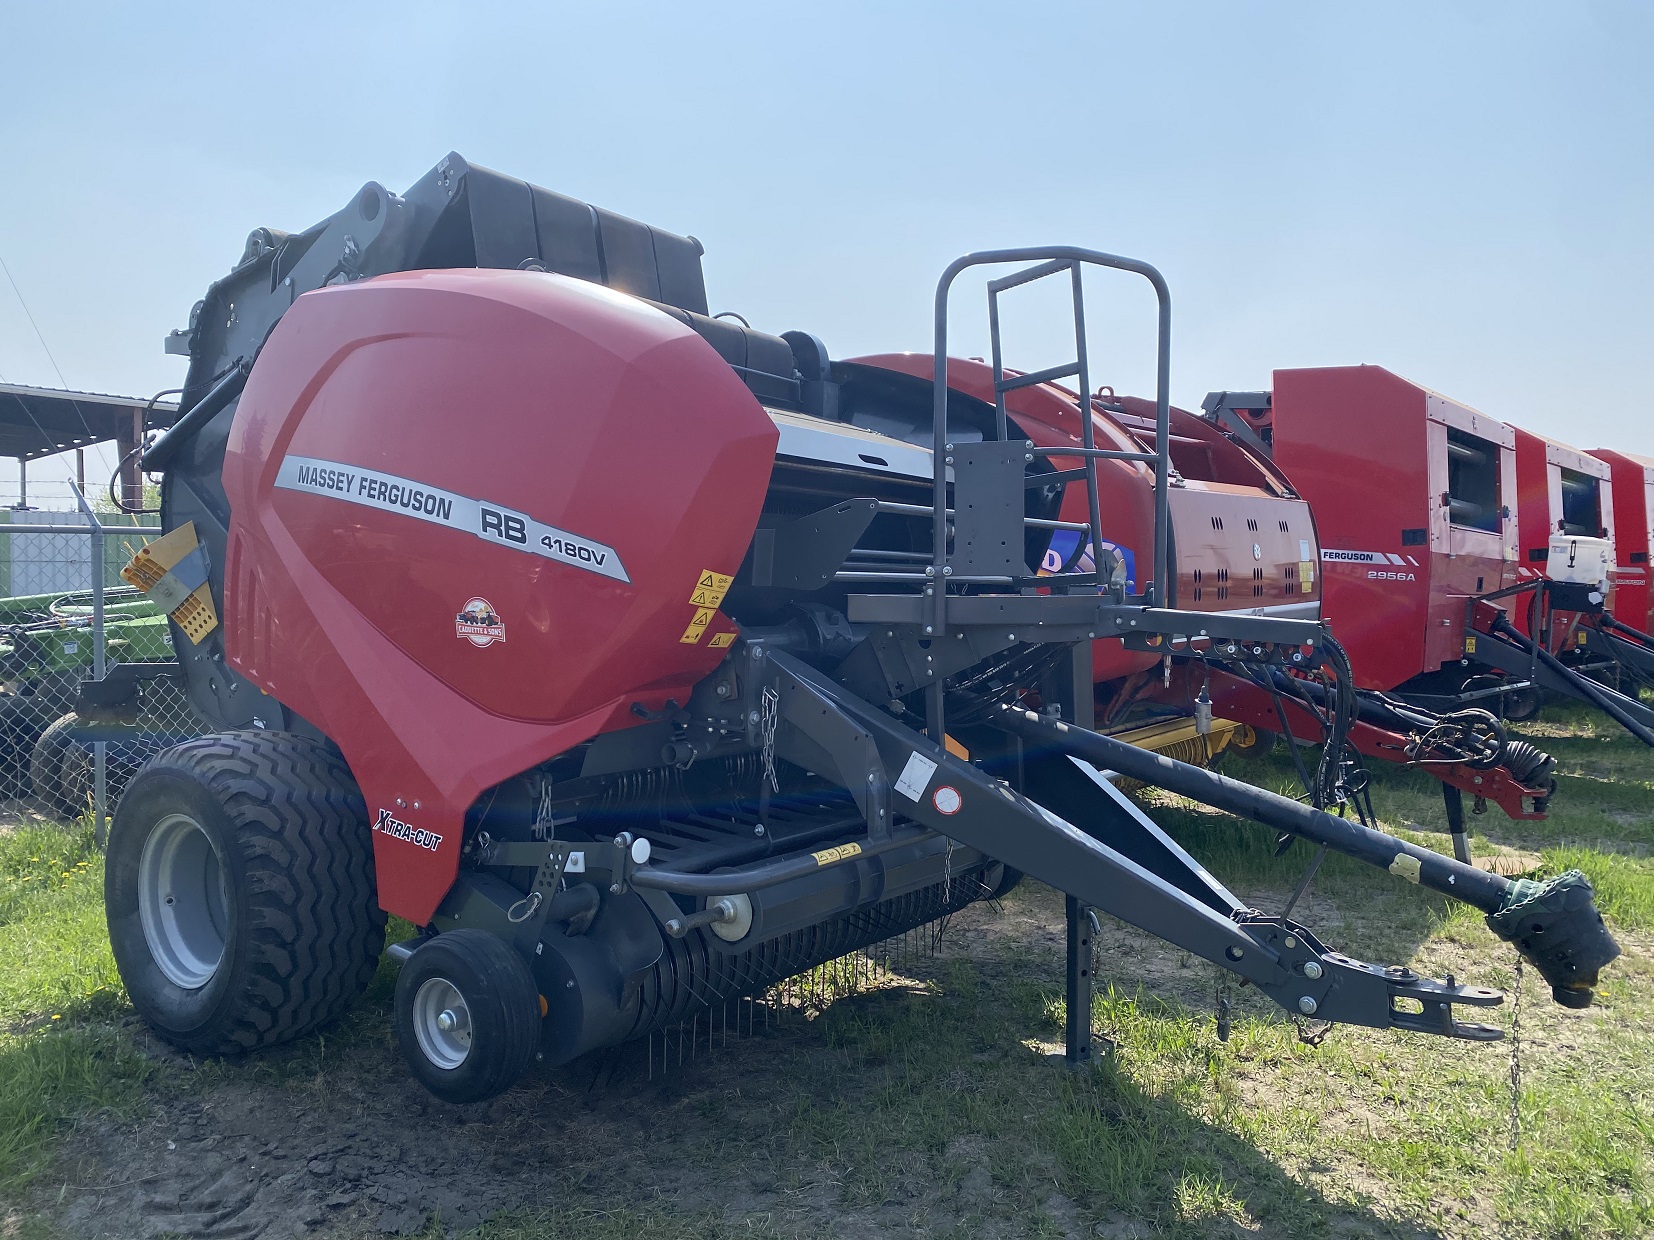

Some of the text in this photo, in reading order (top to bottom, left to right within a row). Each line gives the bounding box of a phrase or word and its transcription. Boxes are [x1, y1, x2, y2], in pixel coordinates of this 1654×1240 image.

[298, 464, 606, 566] MASSEY FERGUSON RB 4180V
[1323, 551, 1374, 562] FERGUSON
[1367, 571, 1416, 582] 2956A
[488, 628, 502, 636] SONS
[372, 808, 443, 851] XTRA-CUT
